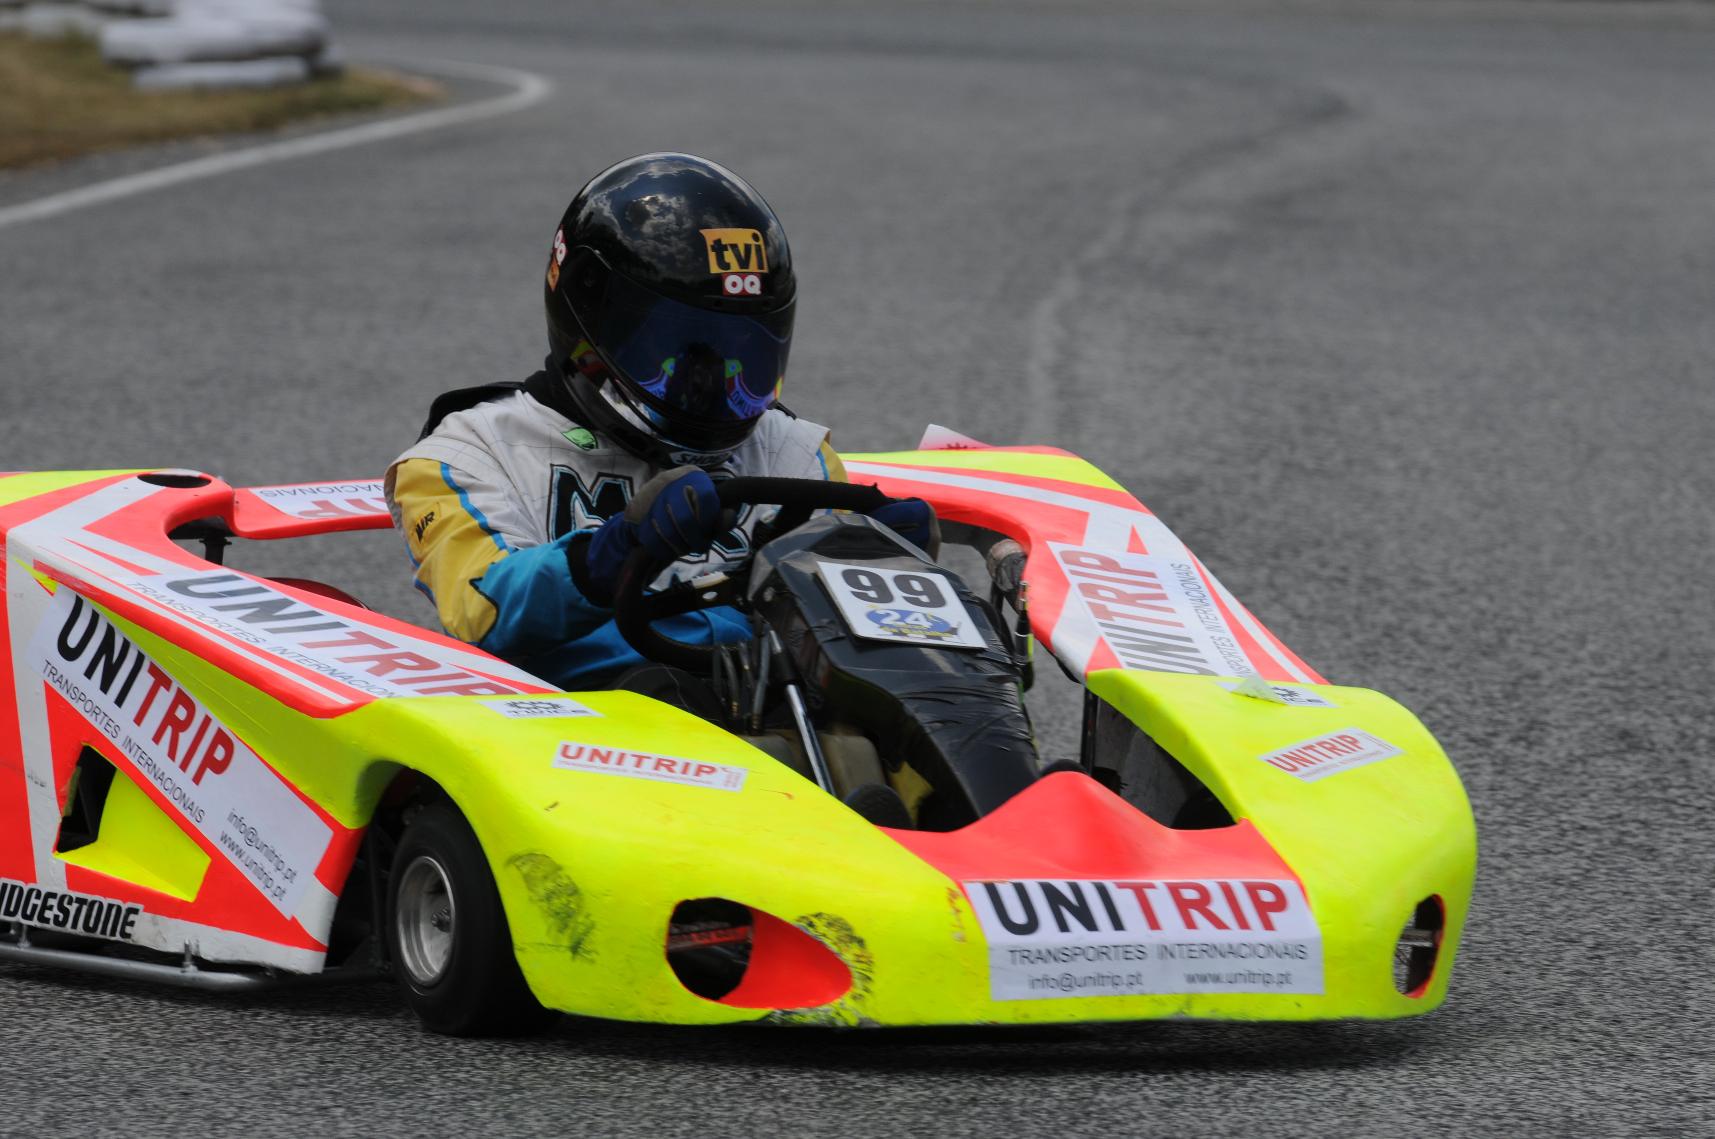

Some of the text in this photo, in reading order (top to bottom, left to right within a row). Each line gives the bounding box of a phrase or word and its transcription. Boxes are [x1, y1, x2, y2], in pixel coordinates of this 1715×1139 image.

[711, 232, 765, 271] tvi
[724, 274, 762, 295] OQ
[125, 581, 267, 643] TRANSPORTES
[842, 568, 947, 609] 99
[1059, 550, 1219, 676] UNITRIP
[1171, 563, 1226, 633] INTERNACIONAIS
[57, 593, 234, 786] UNITRIP
[41, 659, 206, 824] TRANSPORTES INTERNACIONAIS
[560, 744, 718, 778] UNITRIP
[1266, 734, 1365, 773] UNITRIP
[220, 830, 287, 901] www.unitrip.pt
[227, 808, 298, 884] info@unitrip.pt
[982, 881, 1289, 936] UNITRIP
[1009, 942, 1309, 965] TRANSPORTES INTERNACIONAIS
[1028, 969, 1293, 992] info@unitrip.pt www.unitrip.pt
